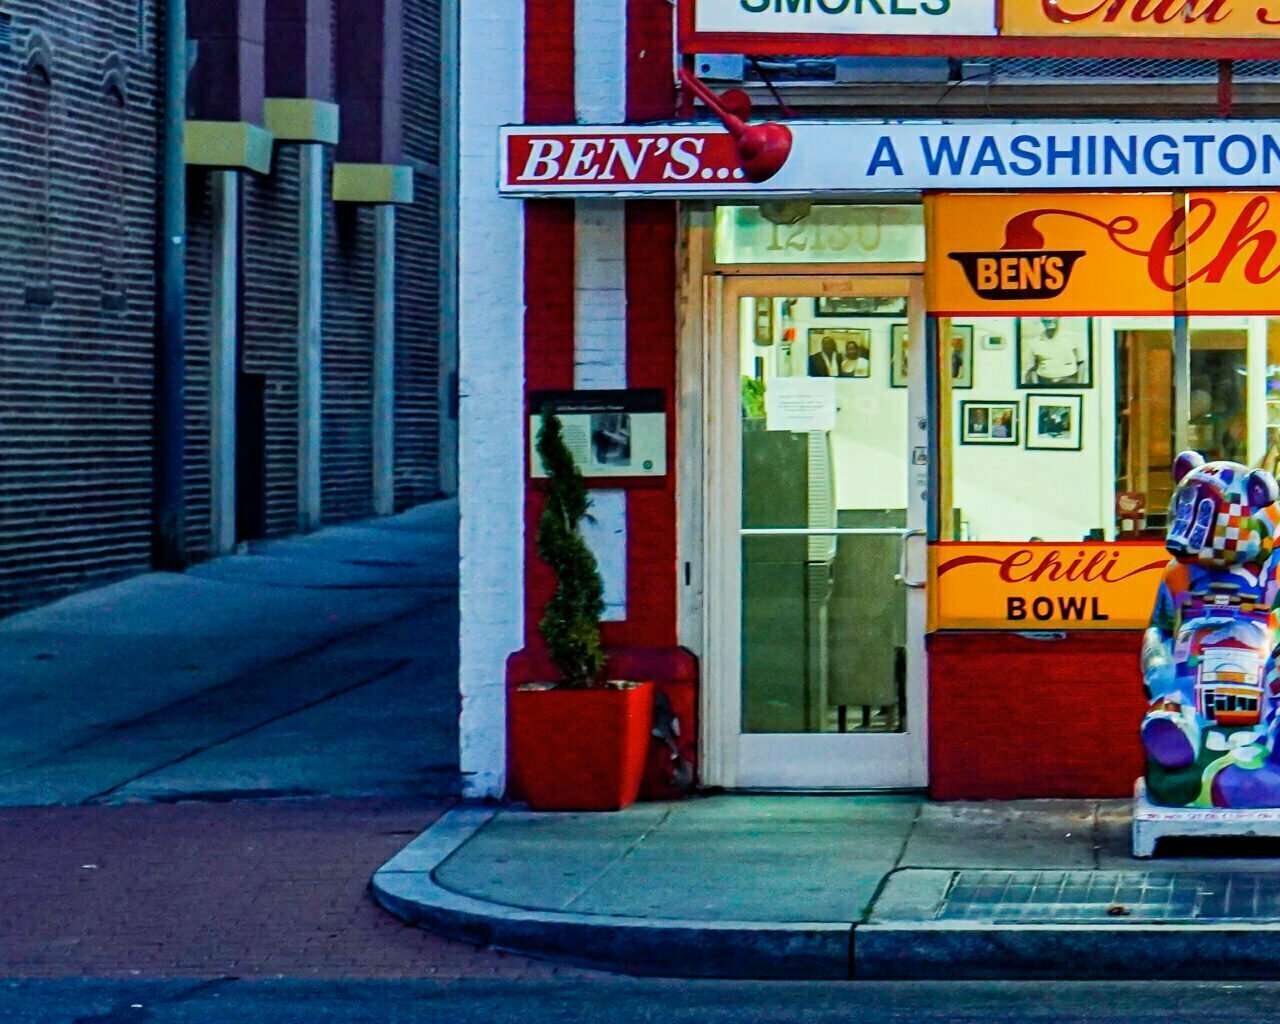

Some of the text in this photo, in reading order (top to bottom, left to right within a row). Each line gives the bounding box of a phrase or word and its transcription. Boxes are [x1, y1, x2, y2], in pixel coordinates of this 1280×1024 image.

[866, 136, 904, 176] A
[977, 255, 1065, 291] BEN'S
[998, 549, 1124, 583] Chili
[1006, 596, 1109, 621] BOWL
